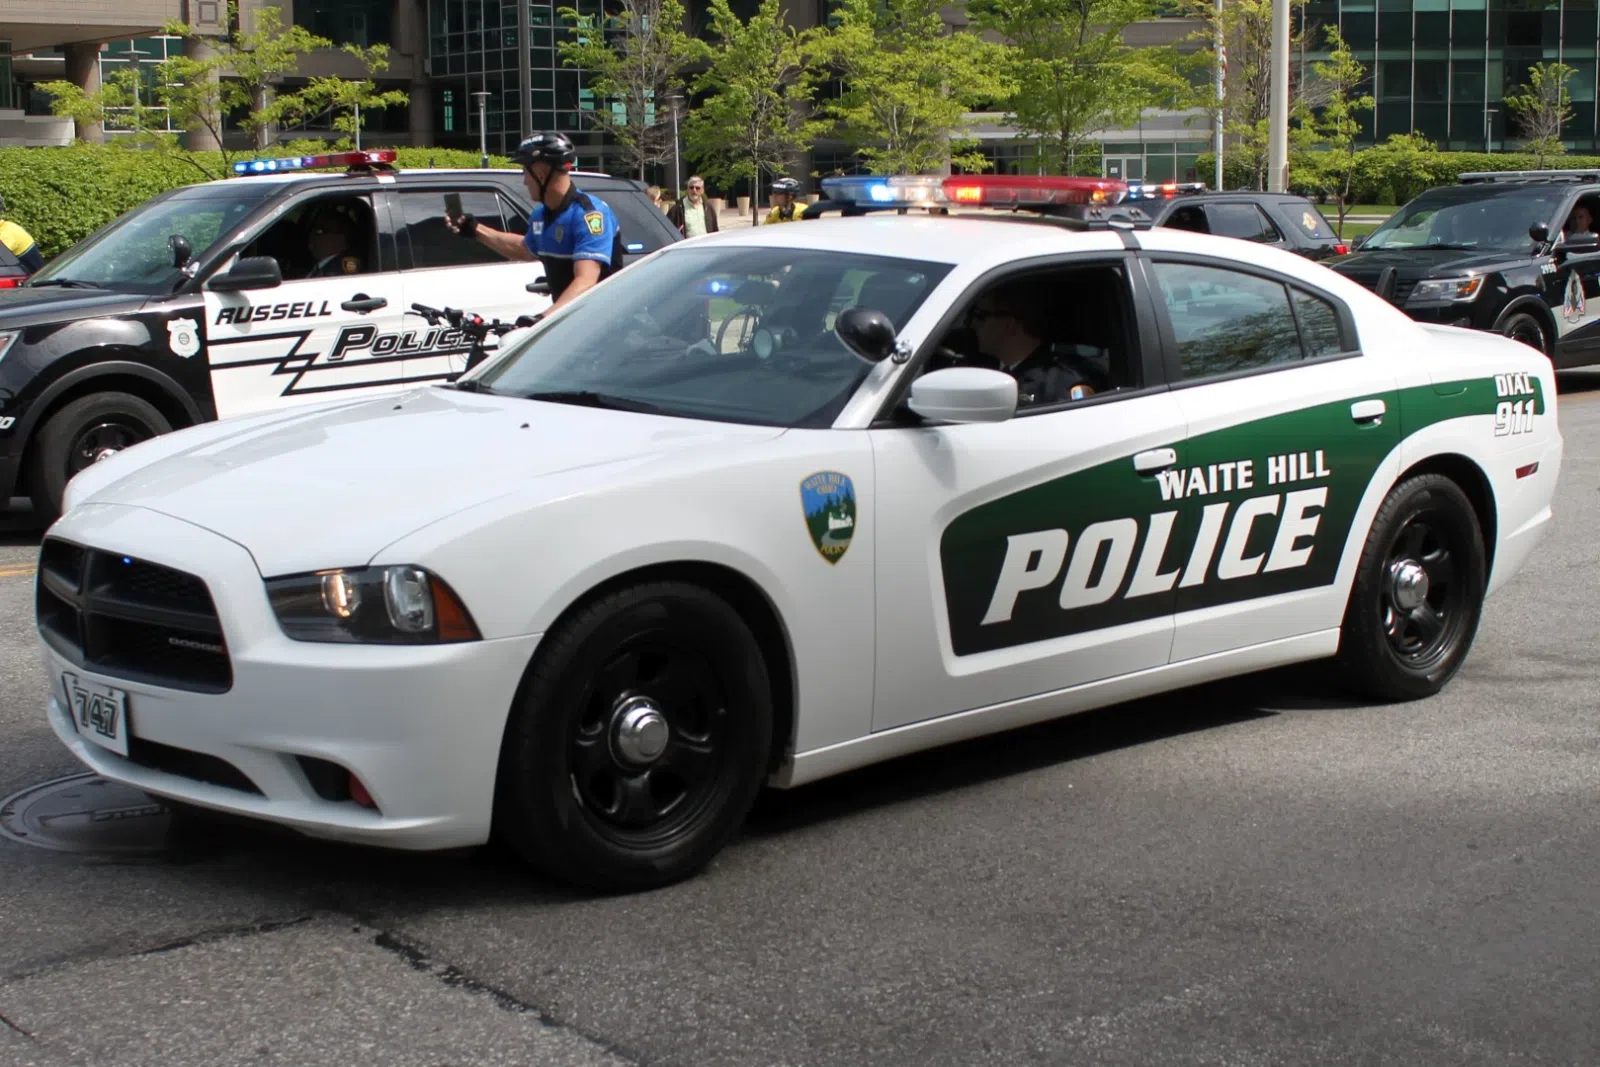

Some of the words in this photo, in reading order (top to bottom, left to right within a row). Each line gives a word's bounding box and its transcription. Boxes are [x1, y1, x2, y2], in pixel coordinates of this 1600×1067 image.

[215, 300, 332, 325] RUSSELL
[1493, 371, 1535, 398] DIAL
[1493, 398, 1536, 437] 911
[1157, 458, 1255, 502] WAITE
[1266, 448, 1332, 487] HILL
[980, 486, 1330, 627] POLICE
[74, 686, 119, 740] 747
